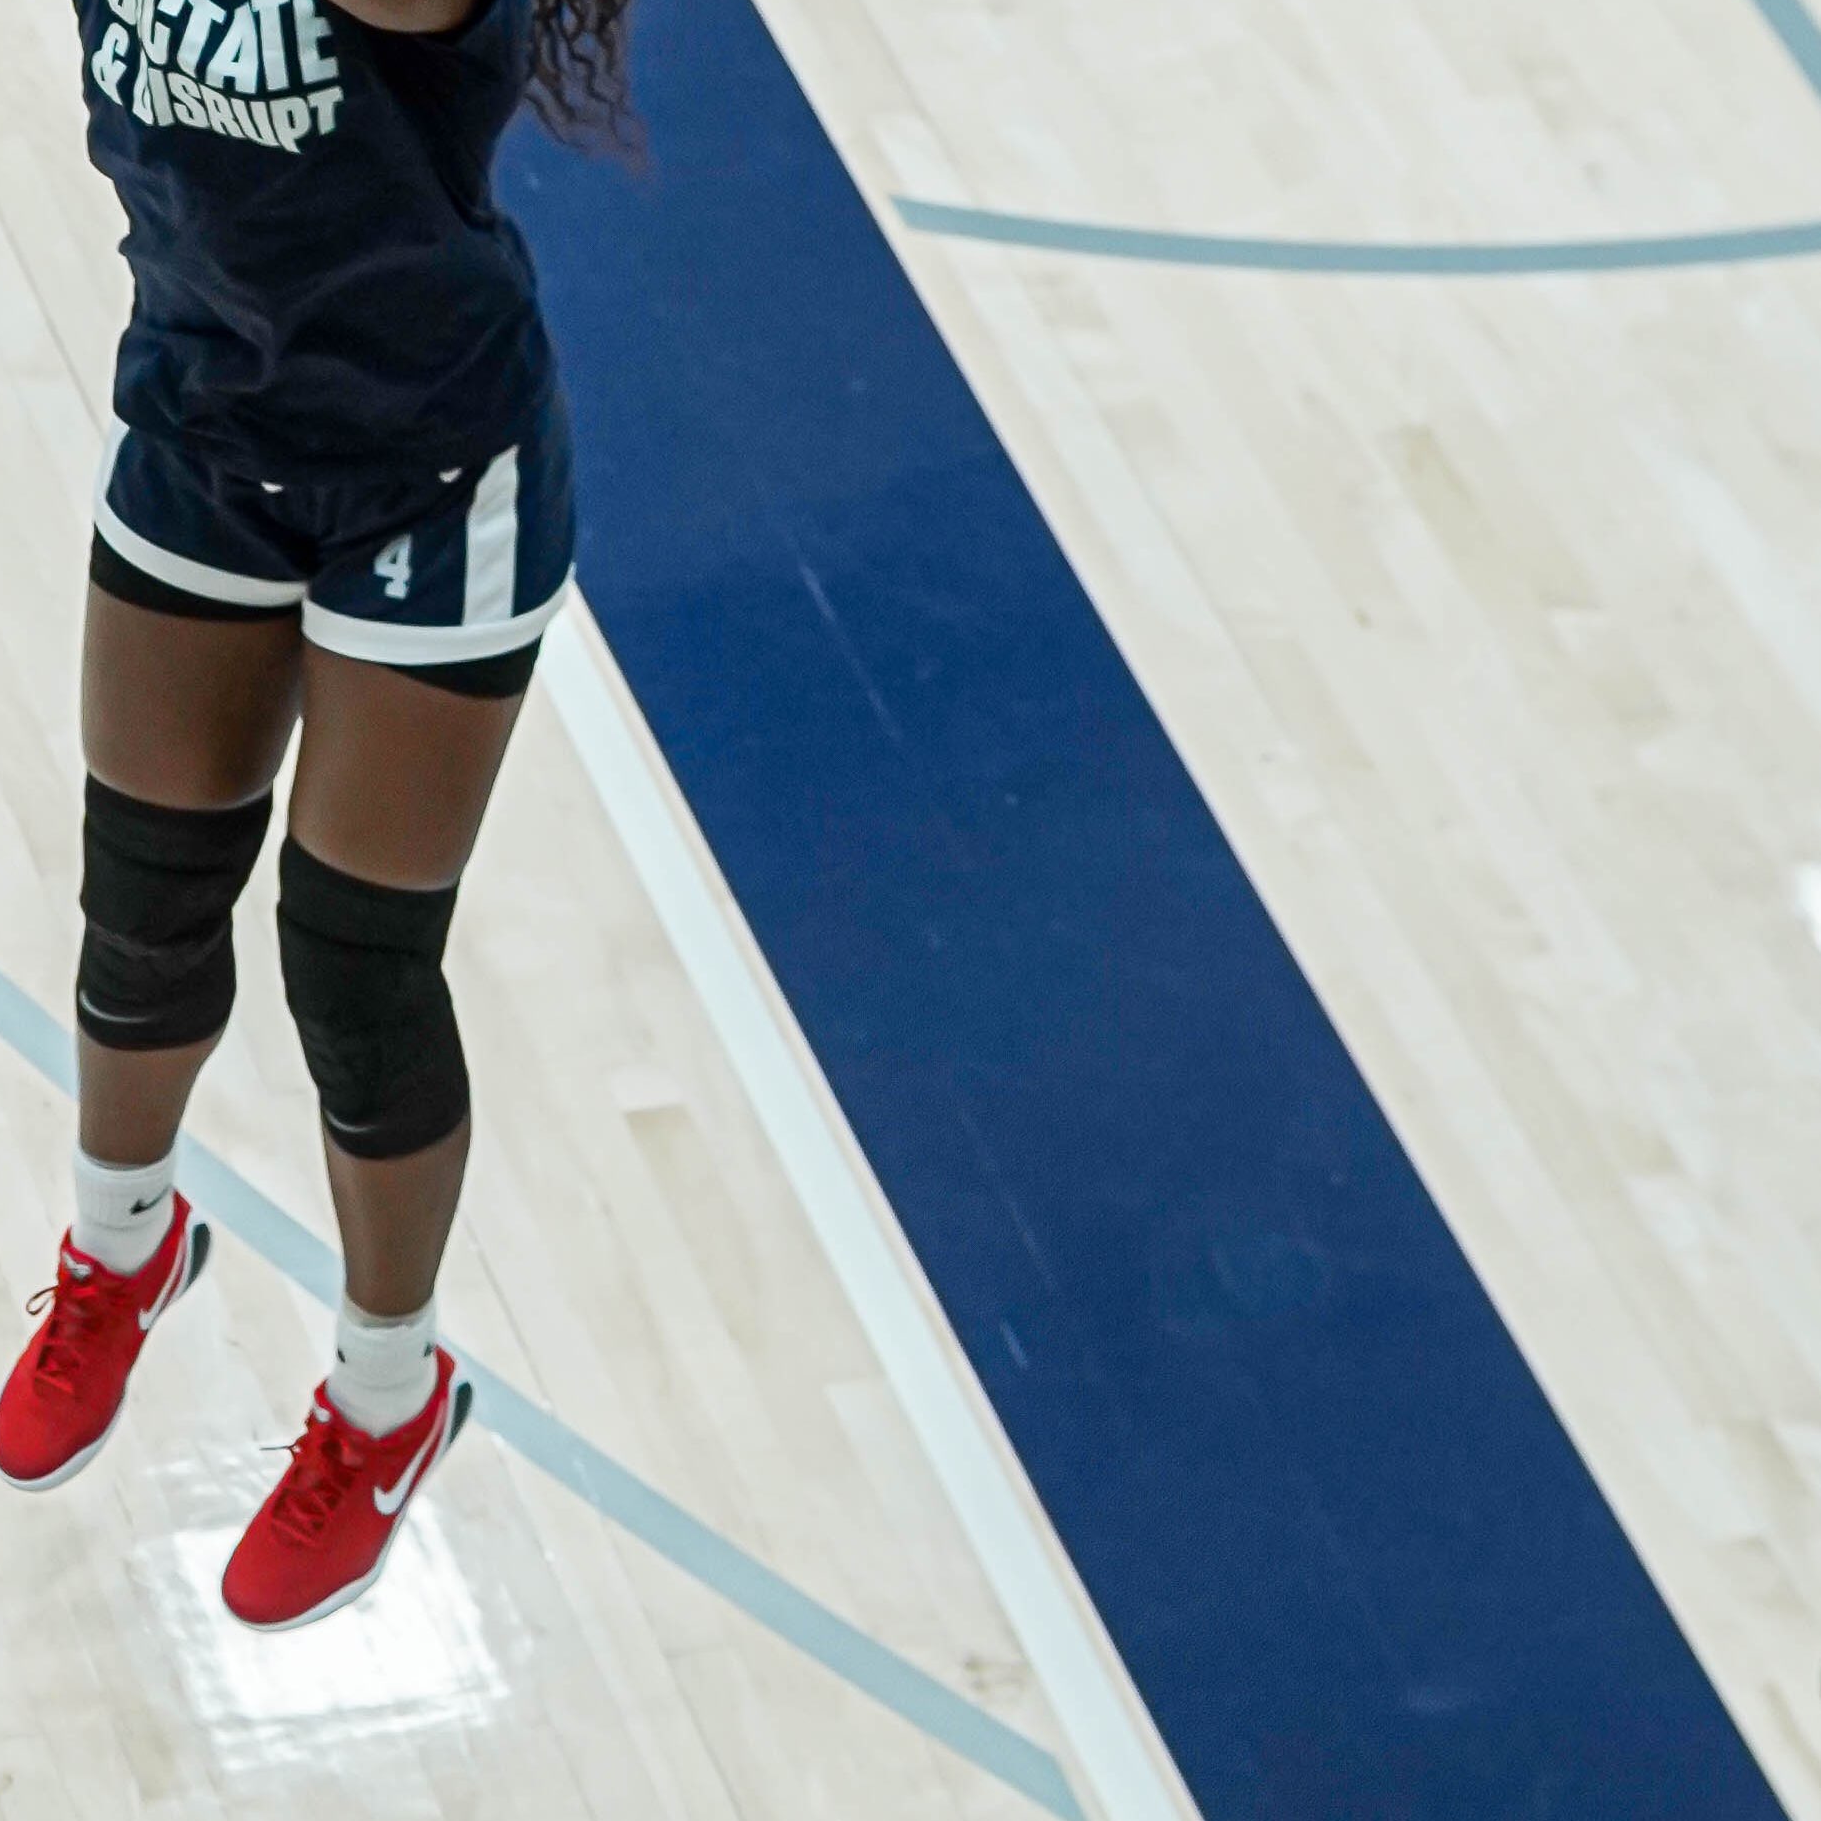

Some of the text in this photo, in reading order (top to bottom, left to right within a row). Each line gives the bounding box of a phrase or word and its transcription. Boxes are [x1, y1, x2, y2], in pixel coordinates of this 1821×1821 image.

[91, 22, 344, 155] & DISRUPT
[373, 532, 413, 600] 4
